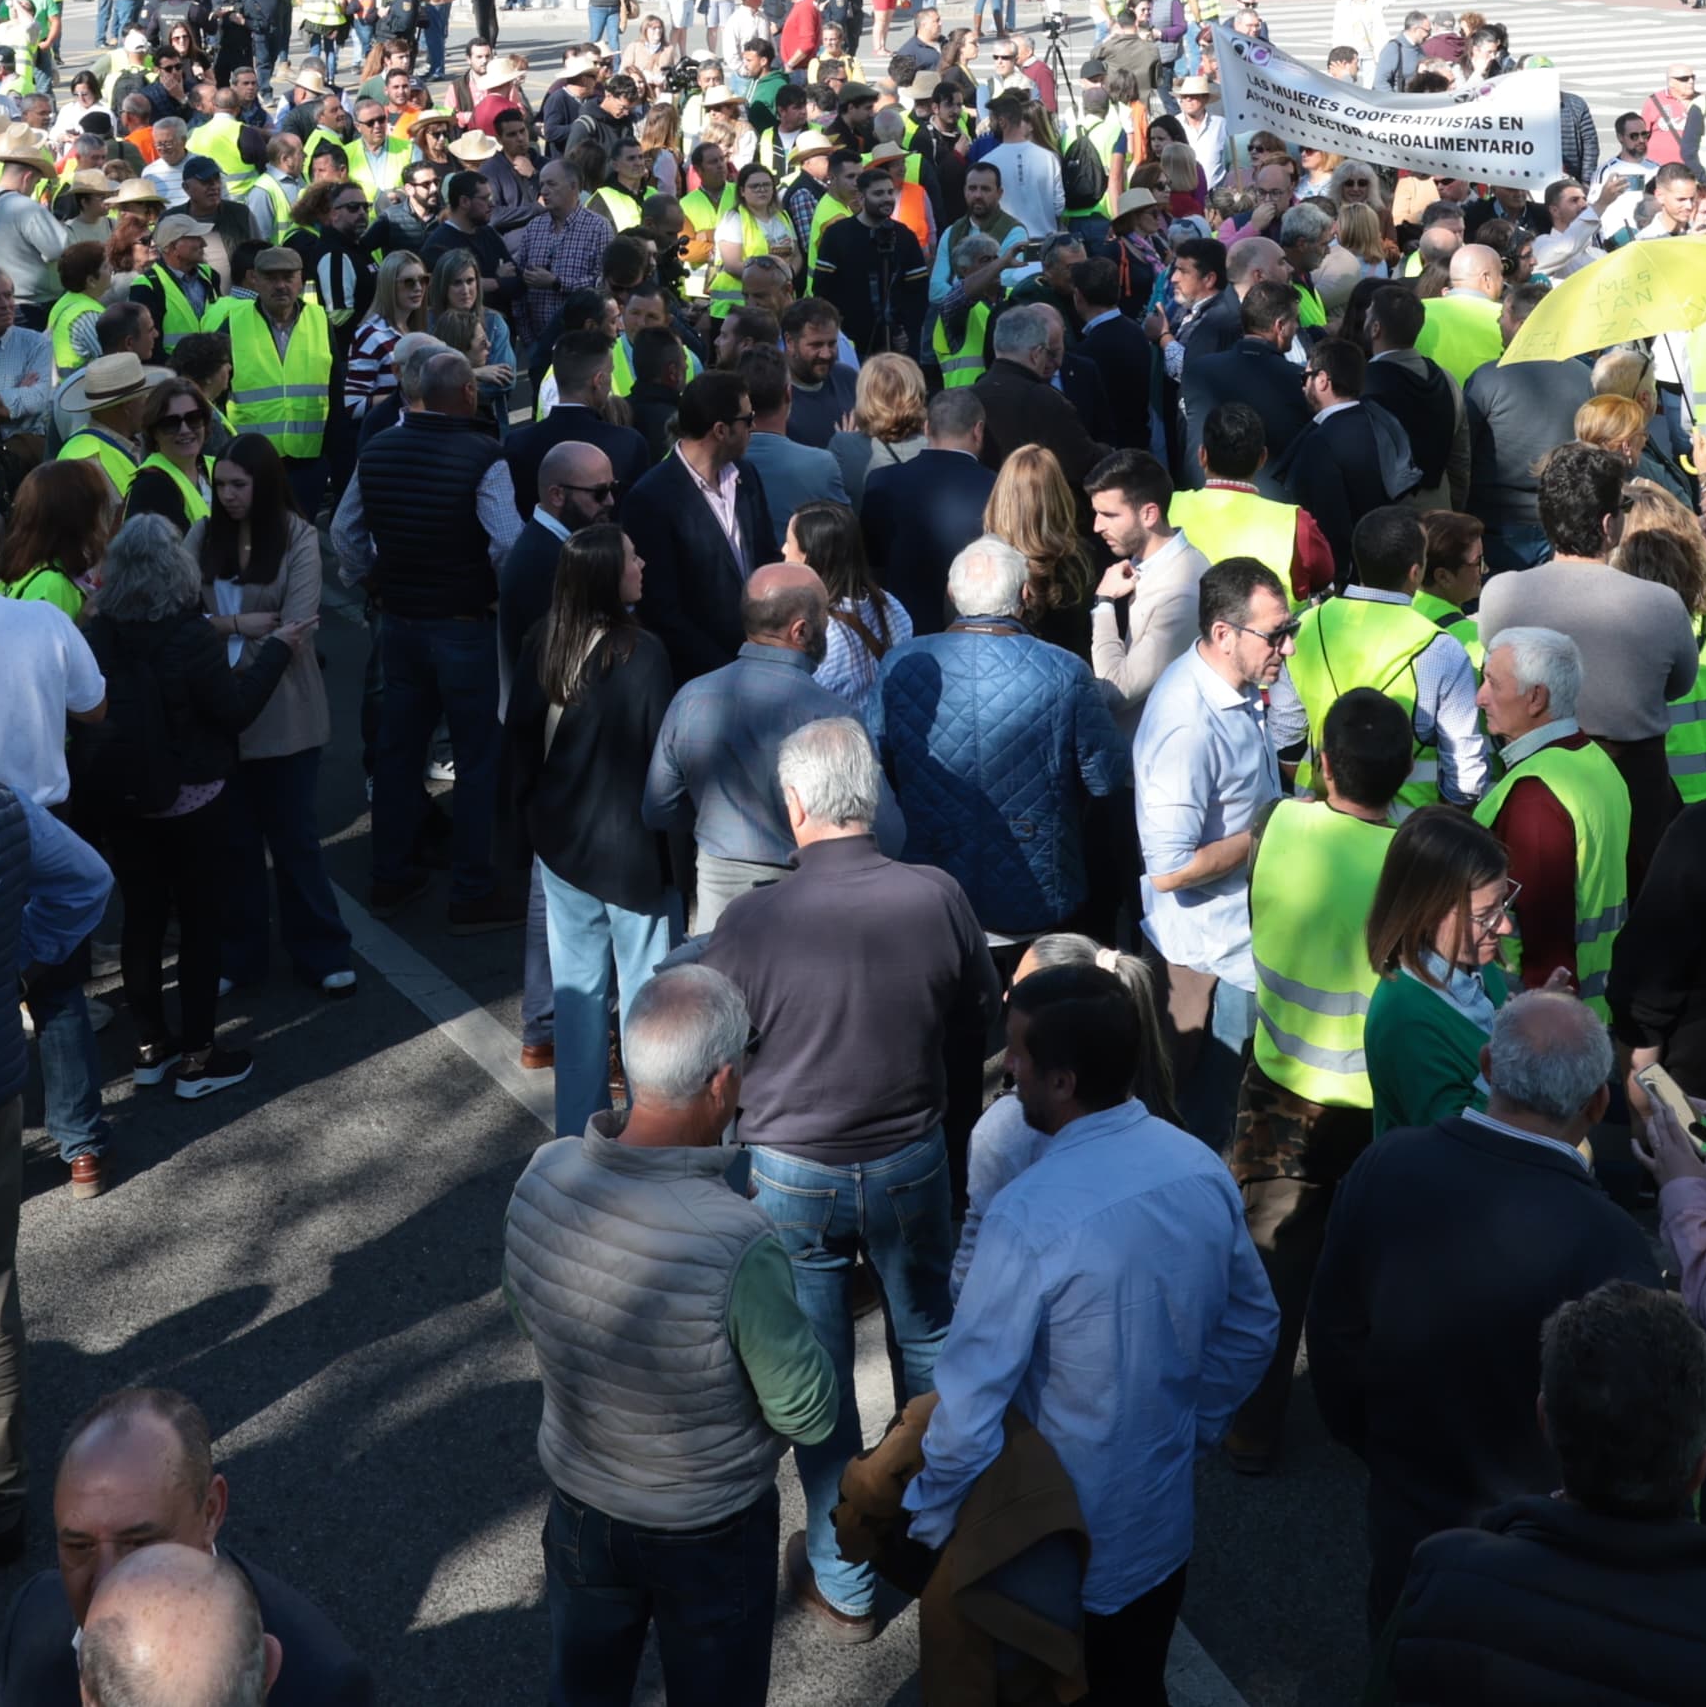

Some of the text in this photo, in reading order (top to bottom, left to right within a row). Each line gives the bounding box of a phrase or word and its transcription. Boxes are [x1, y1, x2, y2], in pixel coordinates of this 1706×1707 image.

[1246, 73, 1524, 131] LAS MUJERES COOPERATIVISTAS EN
[1246, 88, 1534, 156] APOYO AL SECTOR AGROALIMENTARIO
